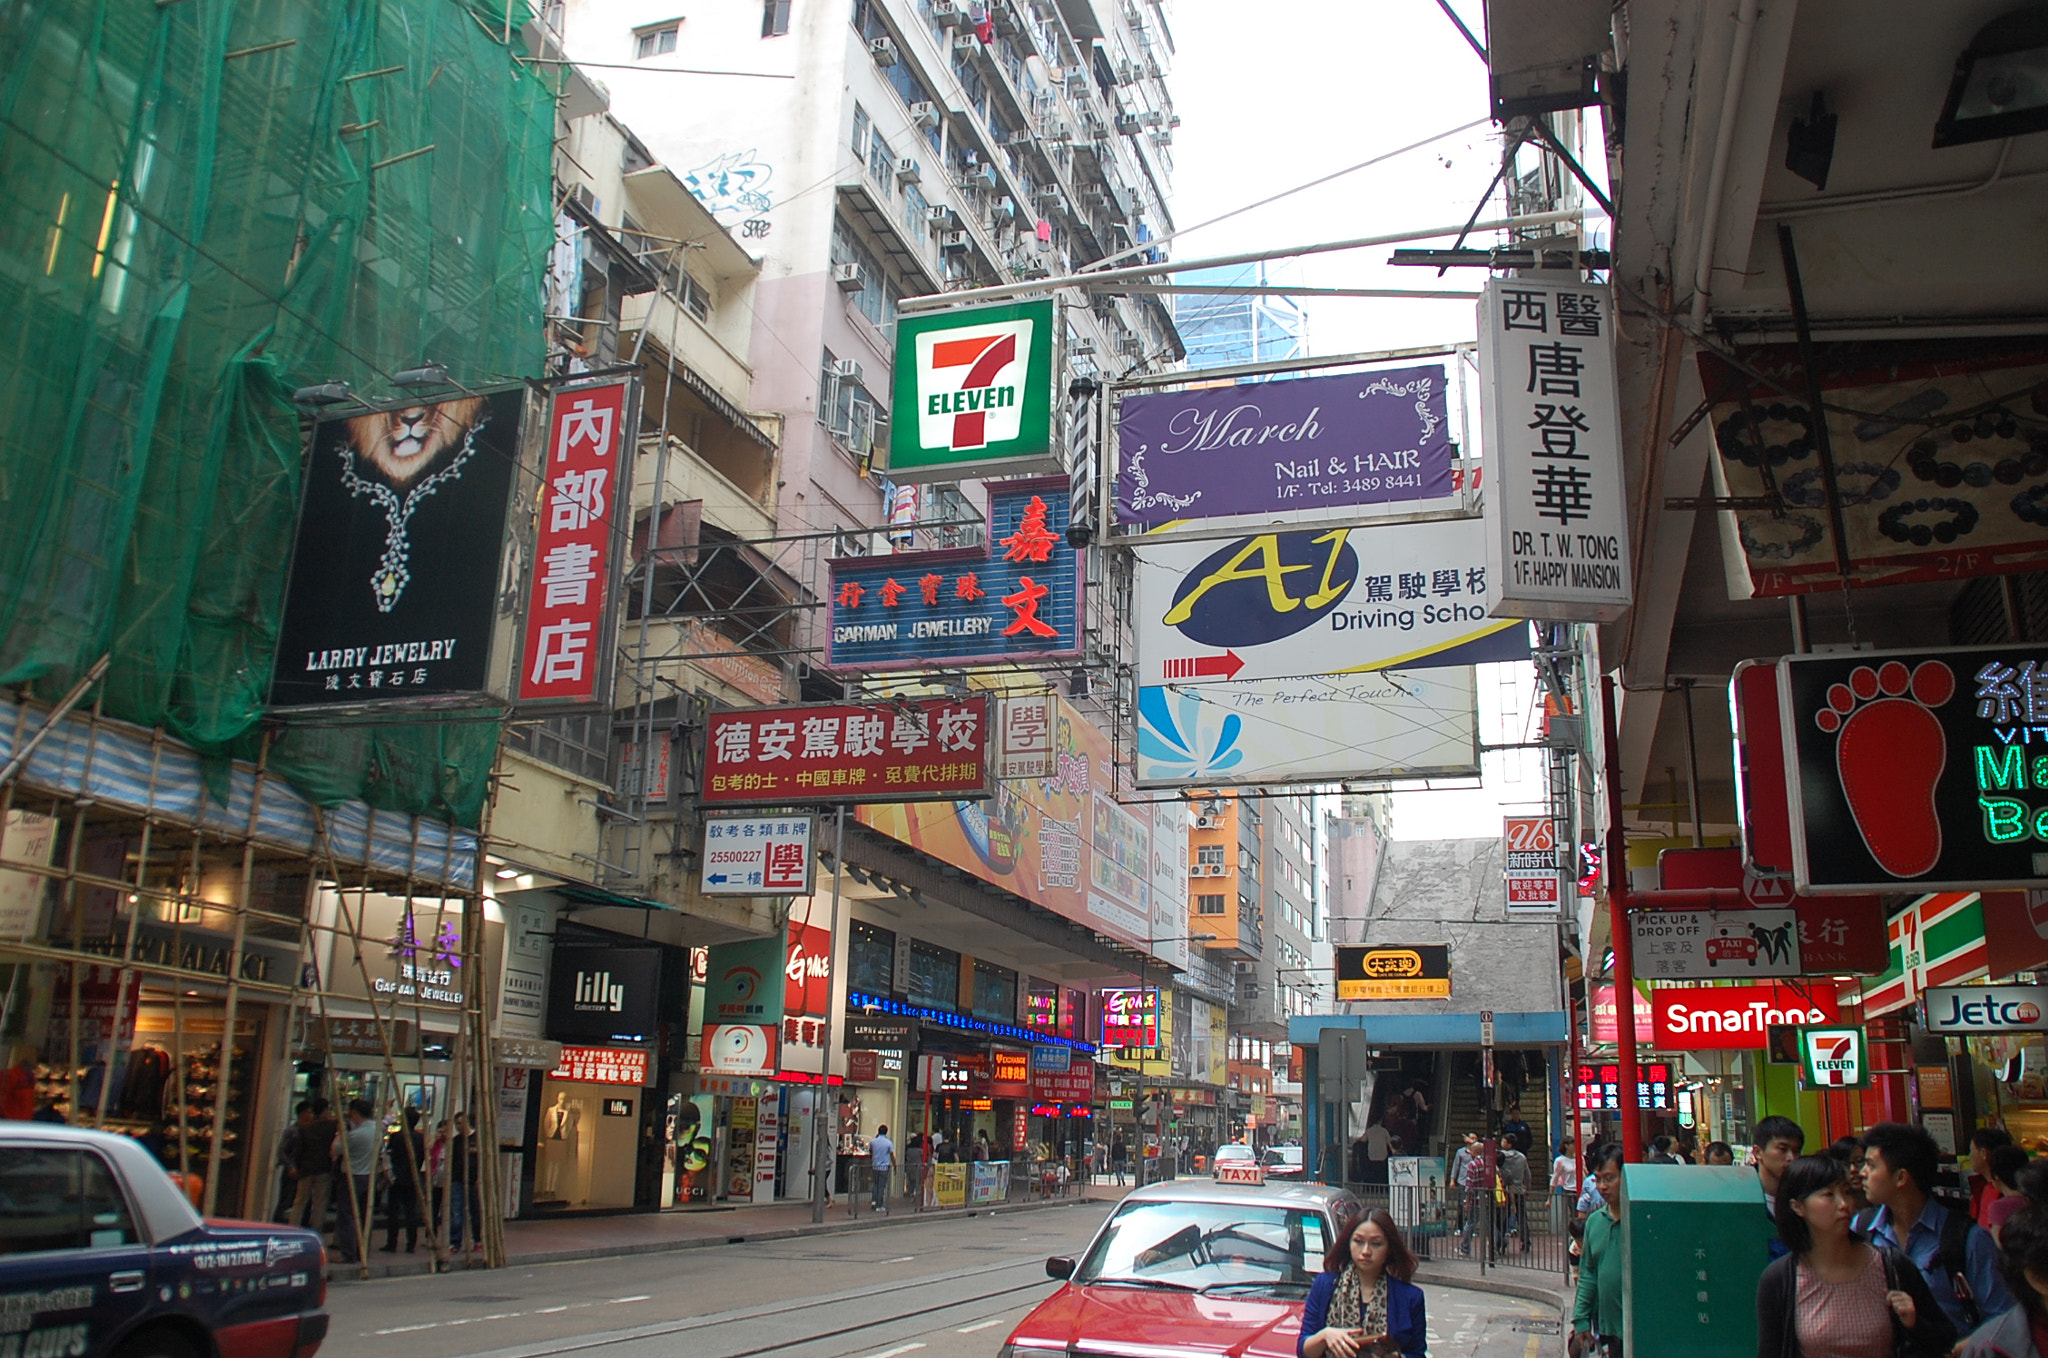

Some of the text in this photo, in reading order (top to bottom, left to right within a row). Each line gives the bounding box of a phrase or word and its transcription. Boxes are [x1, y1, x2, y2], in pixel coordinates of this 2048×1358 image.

[1501, 289, 1602, 337] 西醫
[932, 333, 1016, 448] 7
[1161, 404, 1325, 455] March
[1527, 342, 1592, 526] 唐登華
[1275, 448, 1420, 481] Nail & HAIR
[1310, 477, 1338, 496] Tel:
[1343, 476, 1380, 494] 3489
[1386, 473, 1422, 490] 8441
[530, 398, 613, 685] 內部書店
[1513, 531, 1619, 560] DR. T. W. TONG
[1000, 495, 1060, 638] 嘉文
[1533, 561, 1567, 587] HAPPY
[1571, 563, 1620, 589] MANSION
[908, 616, 993, 639] JEWELLERY
[1332, 607, 1413, 631] Driving
[306, 638, 456, 671] LARRY JEWELRY
[1233, 684, 1409, 706] The Perfect Touch
[714, 708, 979, 764] 德安駕駛學校
[1010, 706, 1048, 747] 學
[710, 851, 762, 863] 25500227
[1509, 852, 1554, 868] 新時代
[730, 872, 762, 886] 二樓
[1637, 915, 1699, 925] PICK UP &
[1637, 926, 1700, 936] DROP OFF
[1647, 941, 1694, 955] 上客及
[1720, 940, 1742, 948] TAXI
[1804, 953, 1849, 962] BANK
[575, 971, 624, 1012] lilly
[1816, 1037, 1851, 1085] 7
[1223, 1167, 1260, 1182] TAXI
